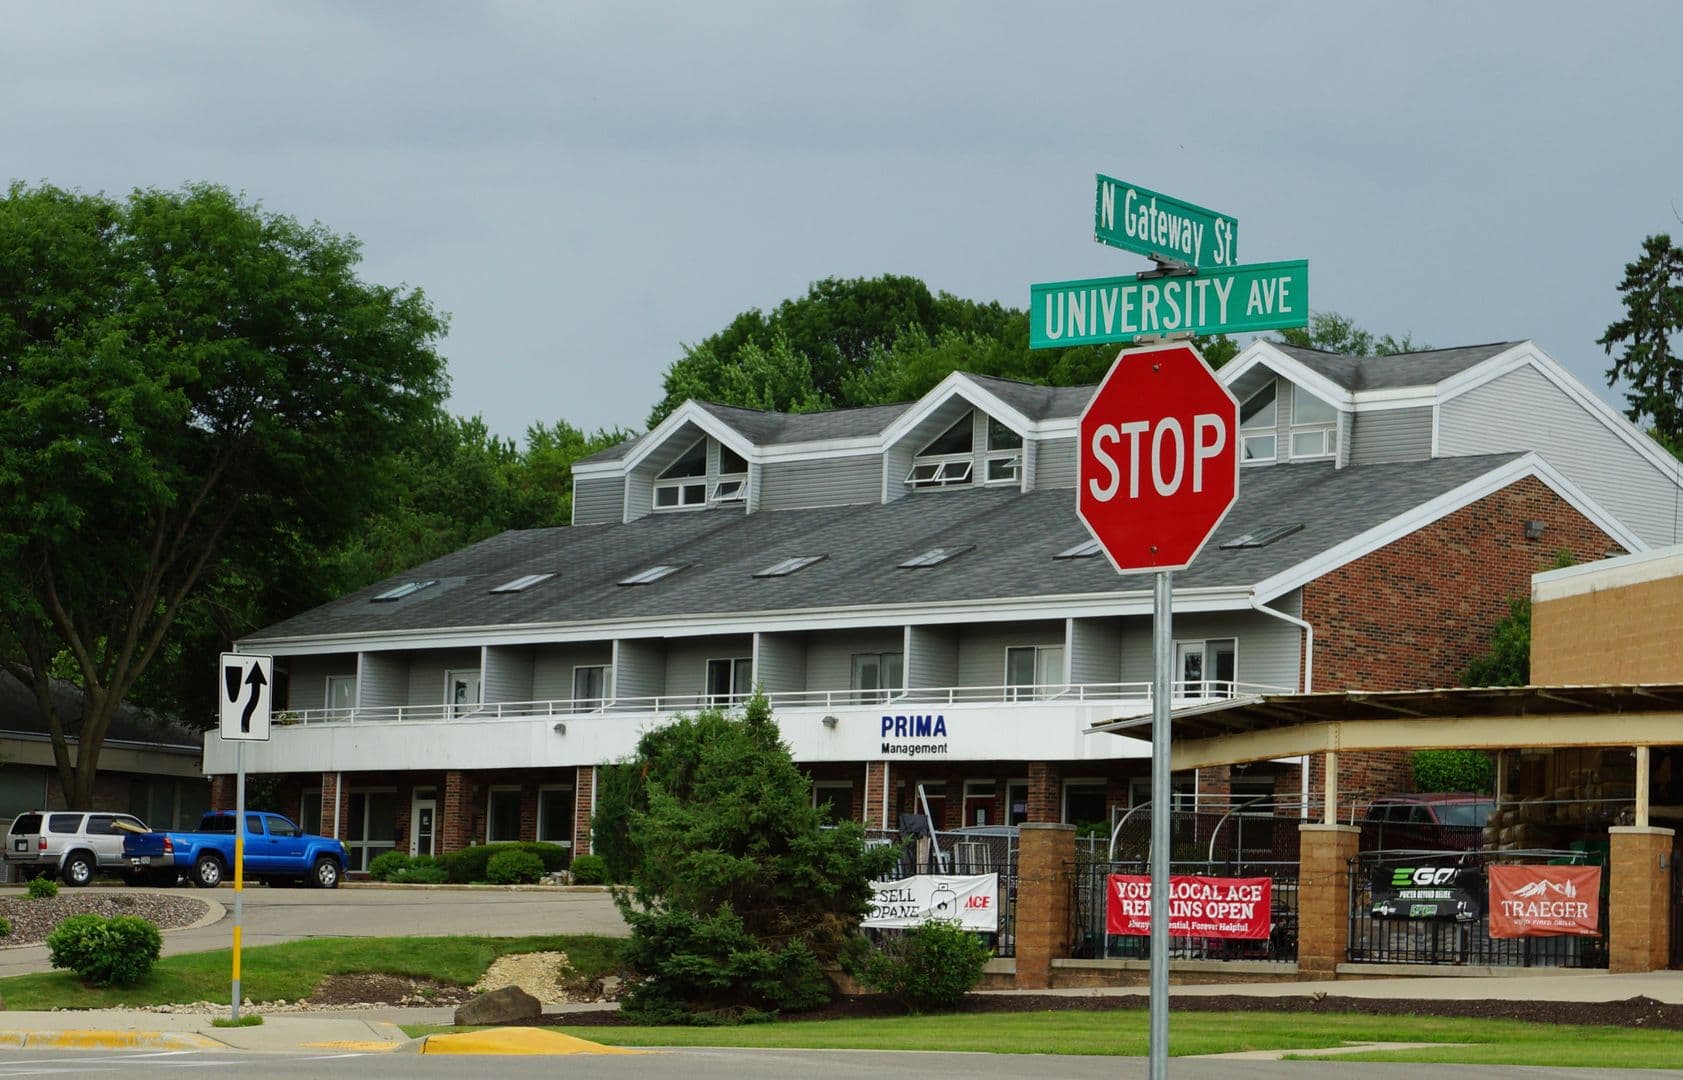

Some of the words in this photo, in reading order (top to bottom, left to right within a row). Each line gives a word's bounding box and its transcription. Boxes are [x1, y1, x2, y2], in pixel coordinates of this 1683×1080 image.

[1101, 181, 1115, 231] N
[1124, 188, 1204, 266] Gateway
[1213, 217, 1233, 266] St
[1045, 276, 1235, 340] UNIVERSITY
[1246, 276, 1292, 316] AVE
[1089, 413, 1226, 502] STOP
[881, 715, 947, 738] PRIMA
[881, 743, 948, 757] Management
[880, 888, 916, 903] SELL
[1116, 881, 1151, 899] YOU
[1169, 882, 1222, 901] LOCAL
[1225, 885, 1262, 902] ACE
[964, 895, 990, 909] ACE
[1501, 901, 1588, 918] TRAEGER
[865, 905, 920, 919] OPANE
[1206, 902, 1255, 920] OPEN
[1128, 920, 1152, 930] Alway
[1219, 922, 1249, 933] Helpful
